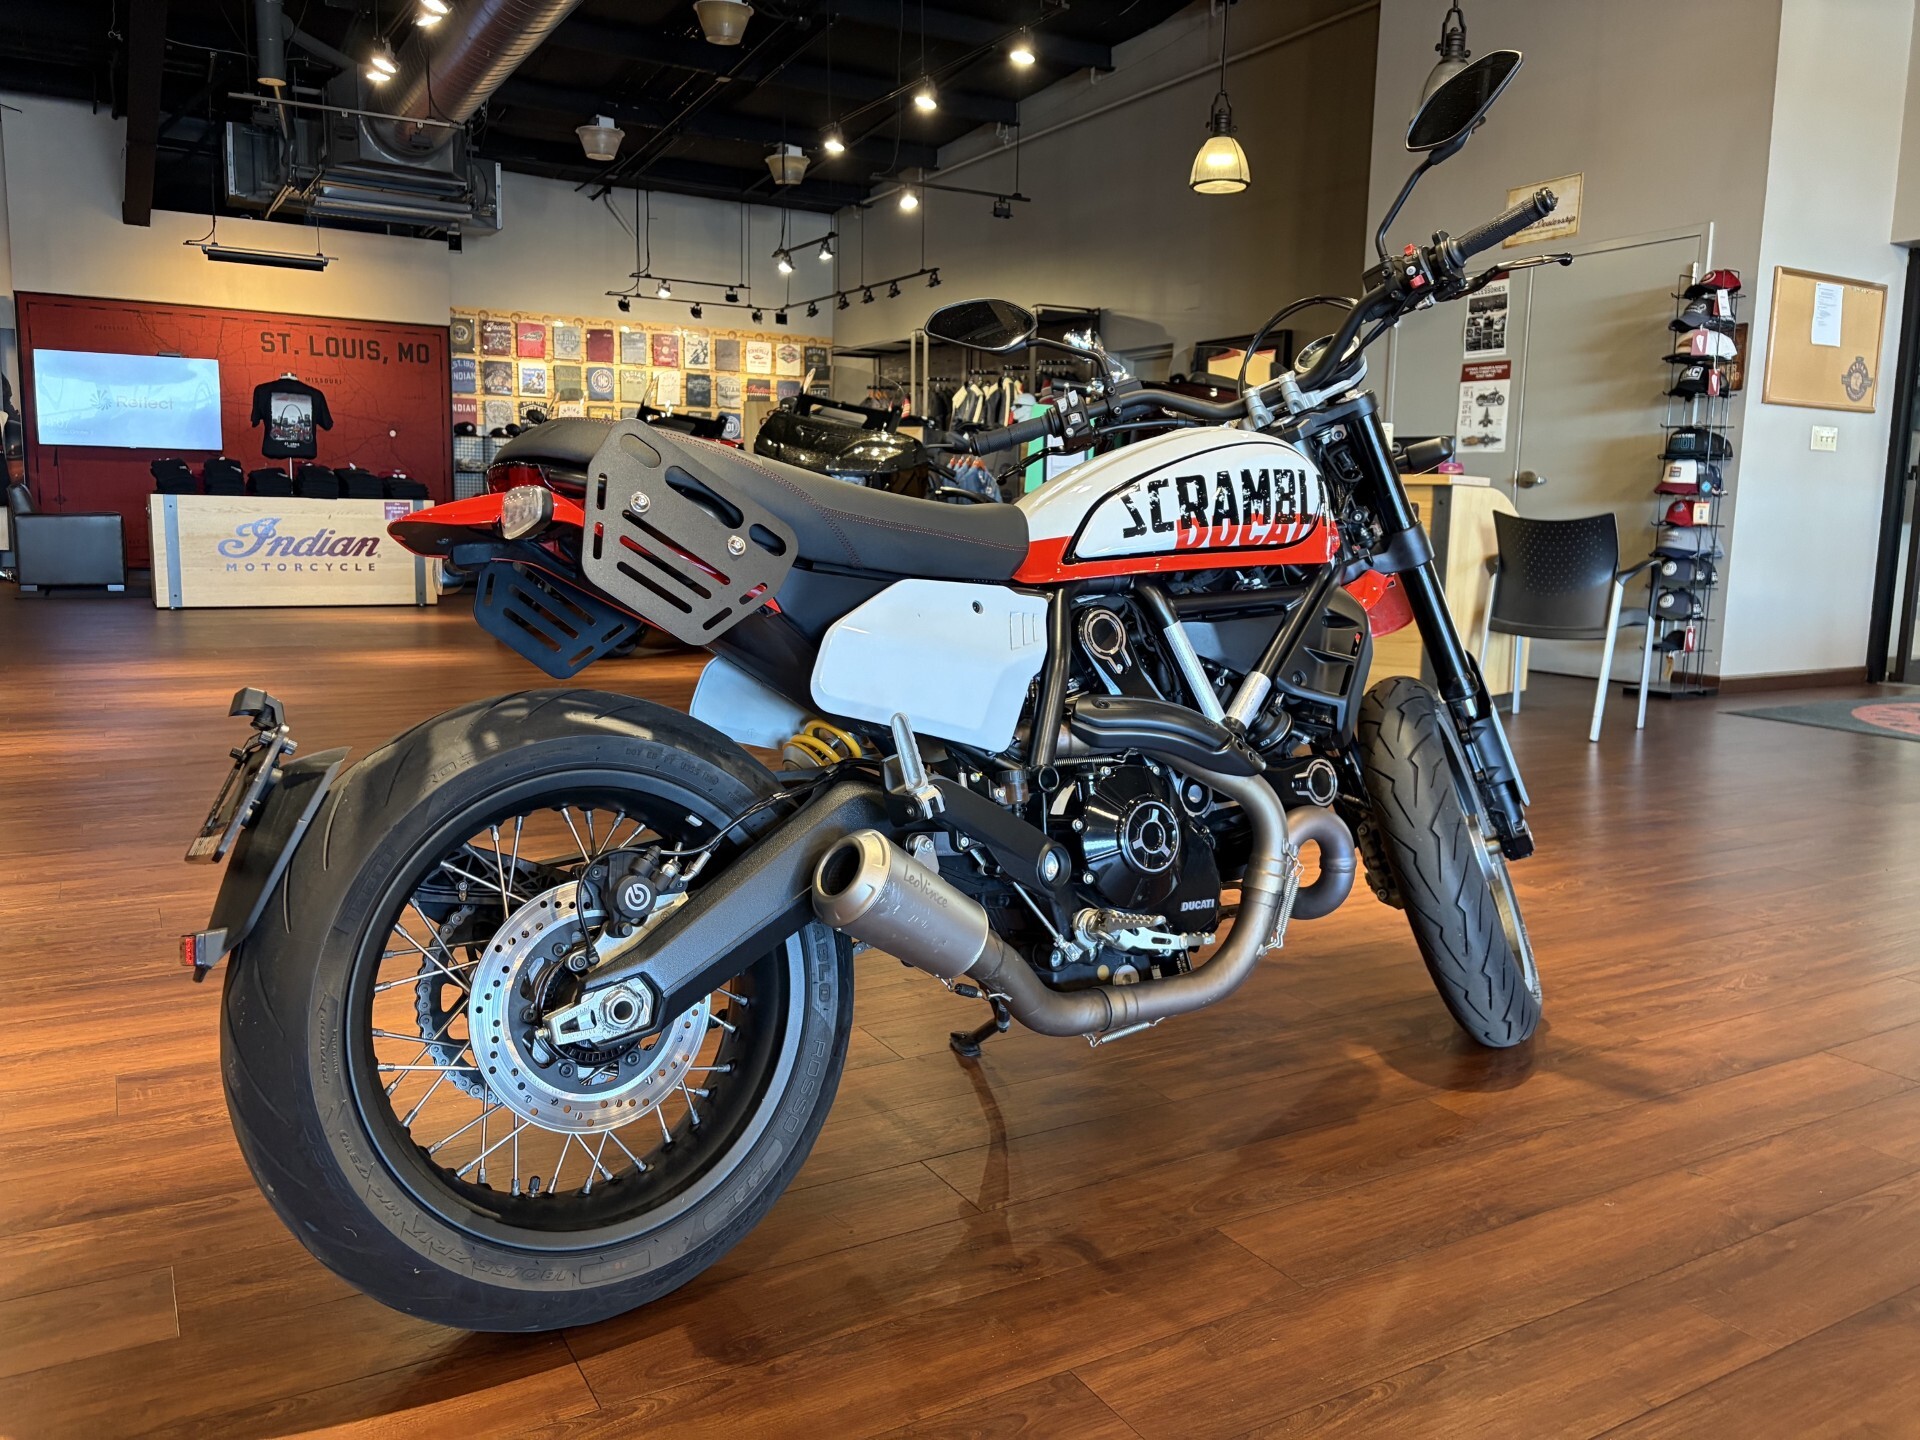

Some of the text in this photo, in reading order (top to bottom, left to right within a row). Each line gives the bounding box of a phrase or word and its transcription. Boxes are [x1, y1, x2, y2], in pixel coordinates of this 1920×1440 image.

[260, 331, 430, 365] ST. LOUIS, MO
[305, 377, 342, 385] MISSOURI
[116, 395, 174, 410] Reflect
[217, 517, 381, 559] Indian
[226, 562, 376, 572] MOTORCYCLE
[903, 863, 949, 909] LeoVince
[1180, 899, 1216, 912] DUCATI
[783, 1039, 827, 1134] ROSSO
[473, 1259, 568, 1282] 180/55
